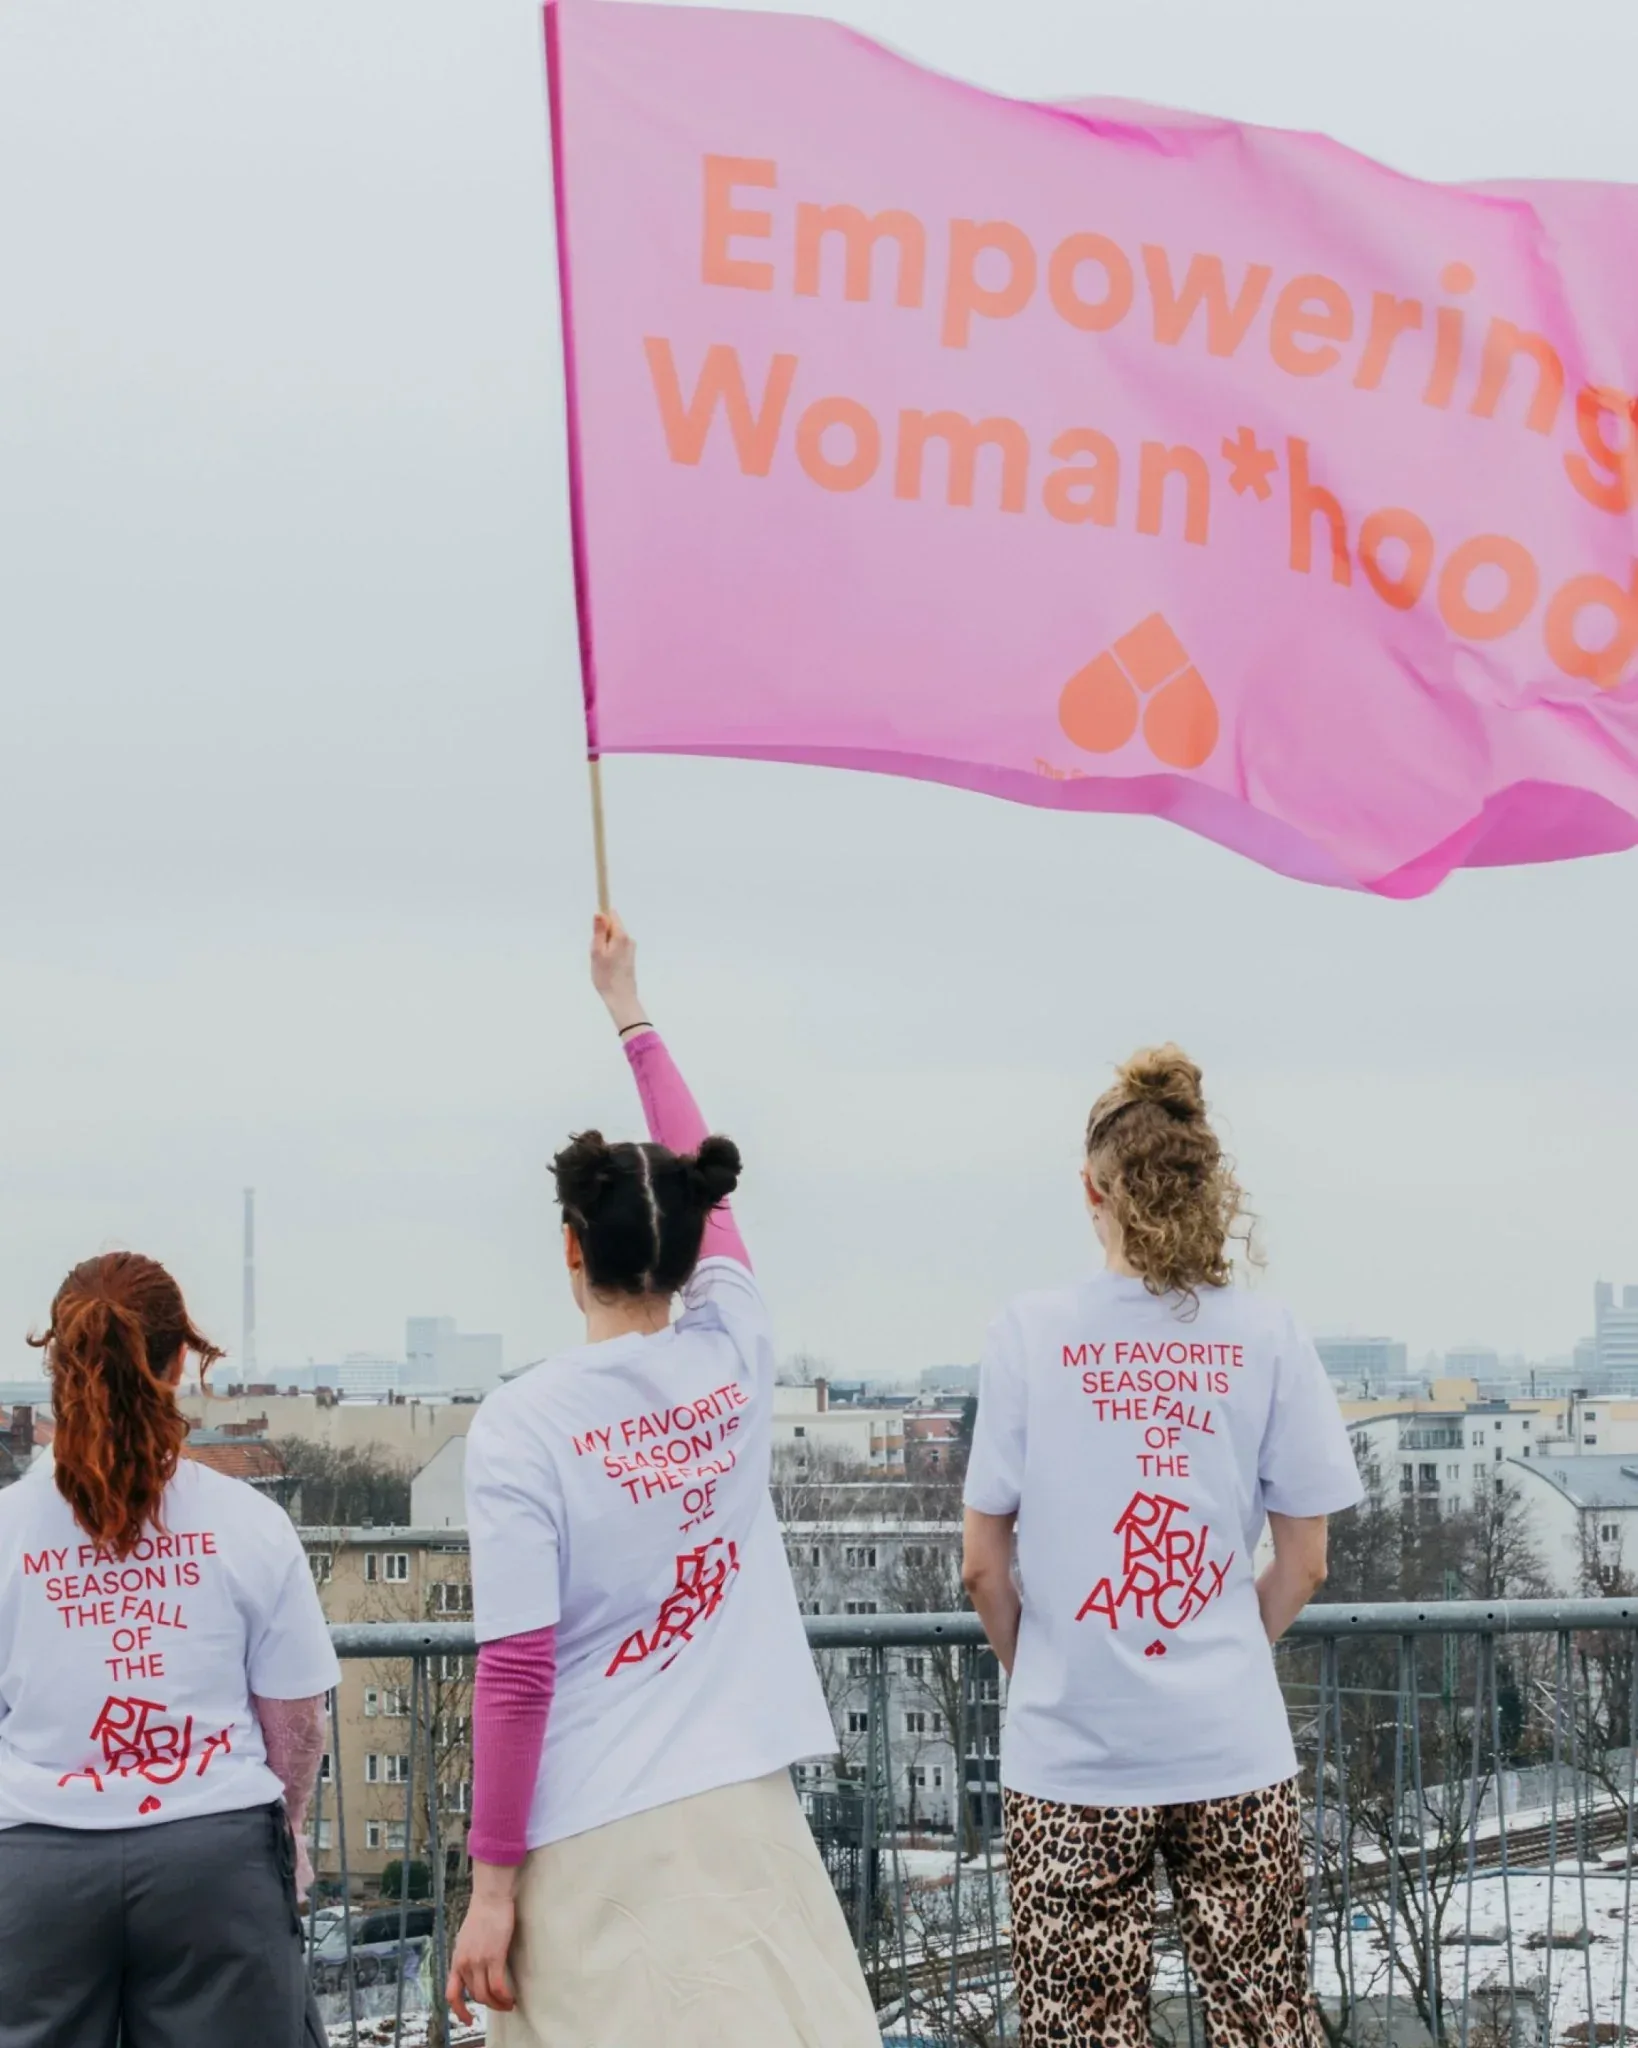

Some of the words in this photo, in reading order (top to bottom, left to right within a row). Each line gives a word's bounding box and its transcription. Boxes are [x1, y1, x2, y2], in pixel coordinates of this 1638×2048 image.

[700, 153, 1638, 517] Empowering
[1062, 1343, 1106, 1367] MY
[1114, 1342, 1244, 1368] FAVORITE
[1082, 1370, 1198, 1394] SEASON
[1207, 1371, 1230, 1394] IS
[572, 1426, 612, 1456] MY
[619, 1383, 749, 1447] FAVORITE
[1092, 1398, 1149, 1422] THE
[1152, 1395, 1216, 1434] FALL
[603, 1430, 713, 1479] SEASON
[719, 1416, 741, 1443] IS
[1144, 1426, 1182, 1449] OF
[1136, 1454, 1190, 1477] THE
[621, 1470, 684, 1505] THE
[682, 1479, 717, 1514] OF
[23, 1547, 69, 1575] MY
[78, 1532, 217, 1568] FAORITE
[46, 1566, 167, 1601] SEASON
[174, 1562, 201, 1587] IS
[57, 1601, 117, 1629] THE
[120, 1596, 188, 1630] FALL
[112, 1626, 152, 1653] OF
[105, 1653, 165, 1682] THE
